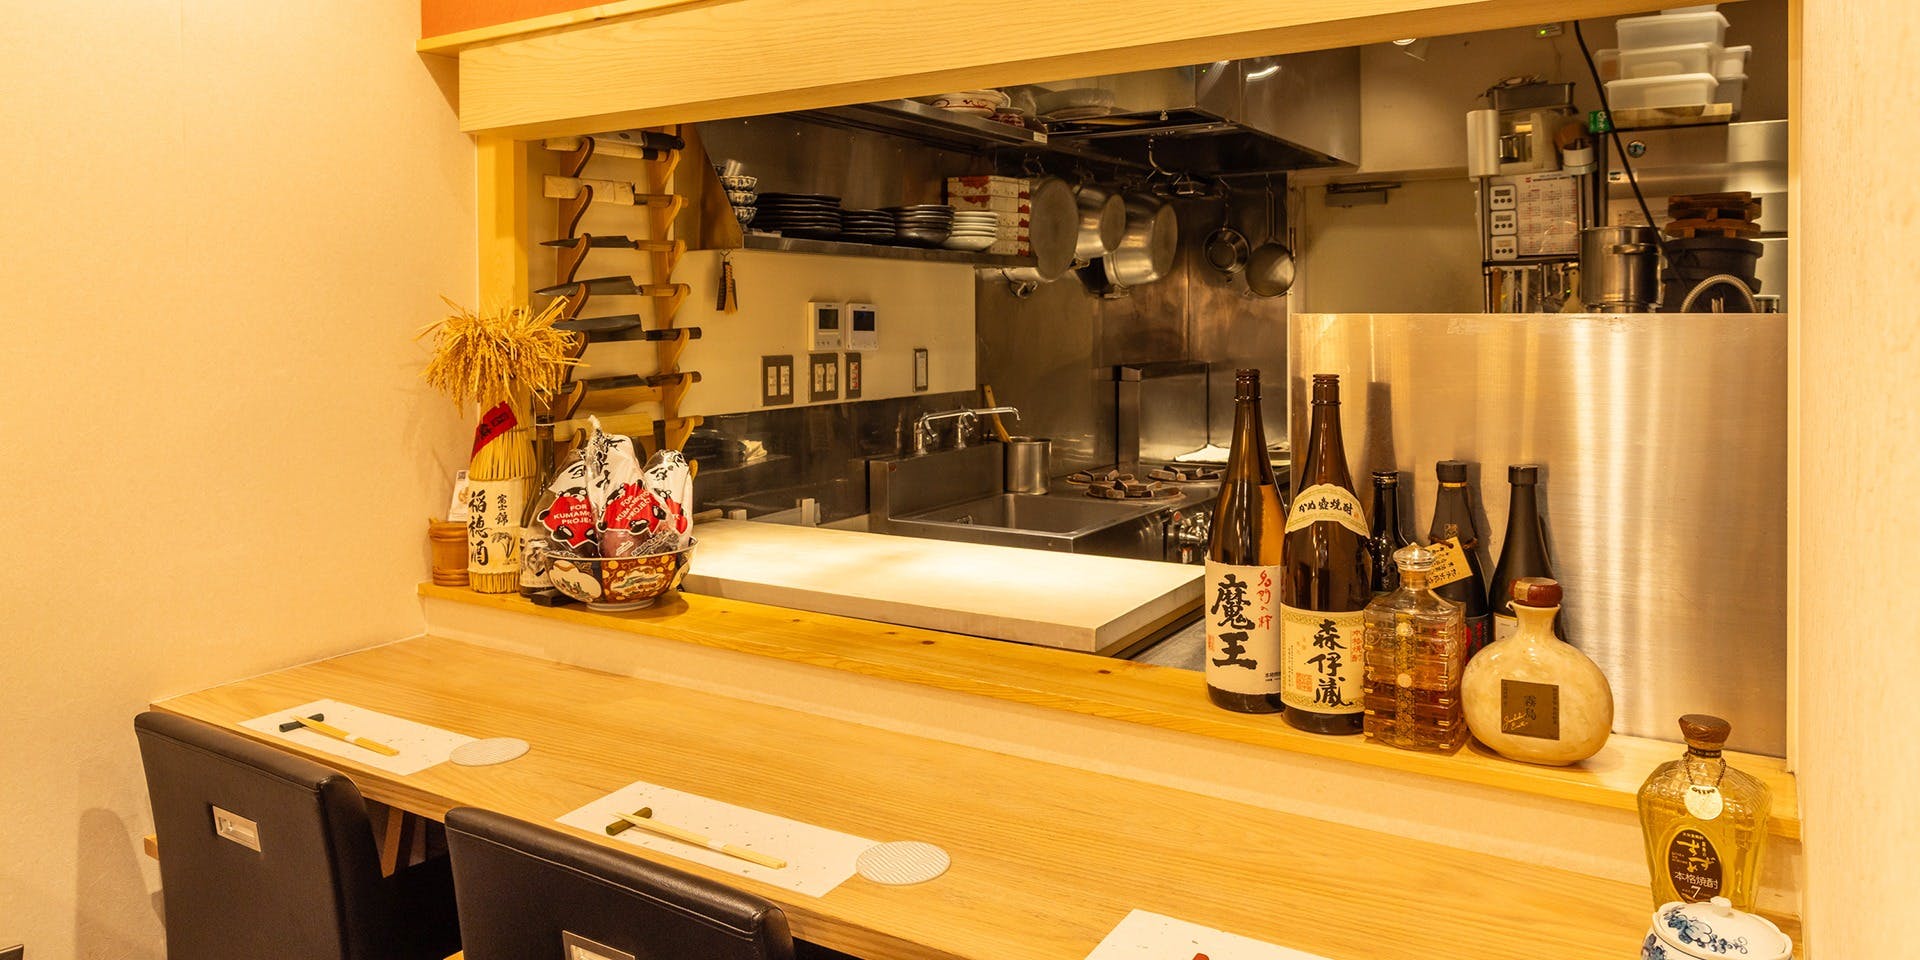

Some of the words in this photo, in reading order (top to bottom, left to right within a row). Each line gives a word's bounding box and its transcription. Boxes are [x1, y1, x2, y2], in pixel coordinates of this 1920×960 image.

[569, 503, 587, 511] FOR
[621, 494, 634, 508] FOR
[468, 489, 492, 566] 稲穂酒
[1210, 573, 1258, 670] 魔王
[1304, 618, 1354, 707] 森伊蔵
[1674, 871, 1718, 890] 本格焼酎
[1691, 885, 1701, 899] 7
